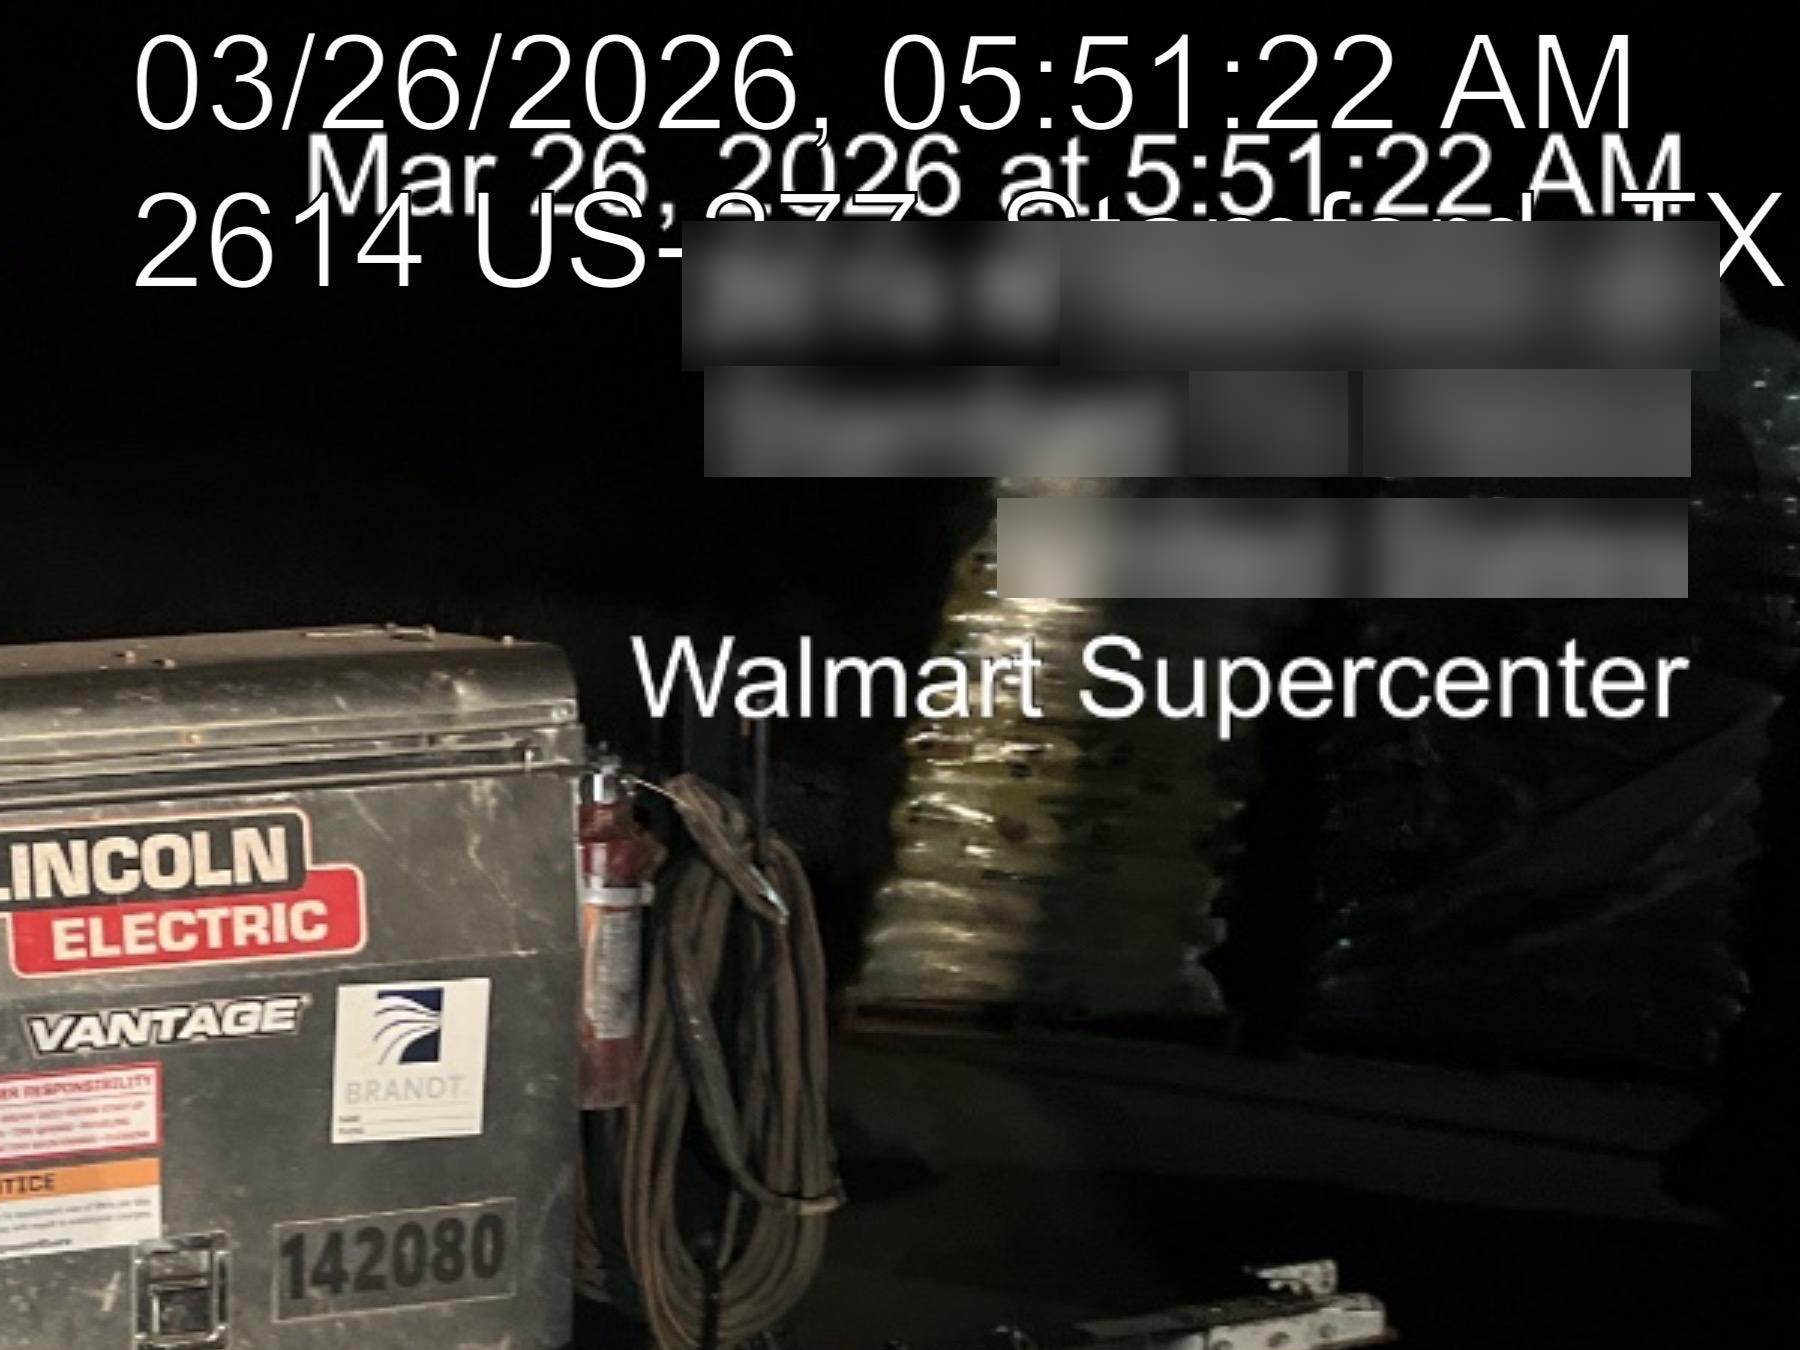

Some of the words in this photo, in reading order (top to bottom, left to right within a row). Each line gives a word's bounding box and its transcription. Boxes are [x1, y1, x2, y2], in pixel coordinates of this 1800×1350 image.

[50, 898, 330, 962] ELECTRIC
[27, 997, 300, 1054] VANTAGE
[344, 1074, 465, 1106] BRANDT
[279, 1212, 505, 1301] 142080
